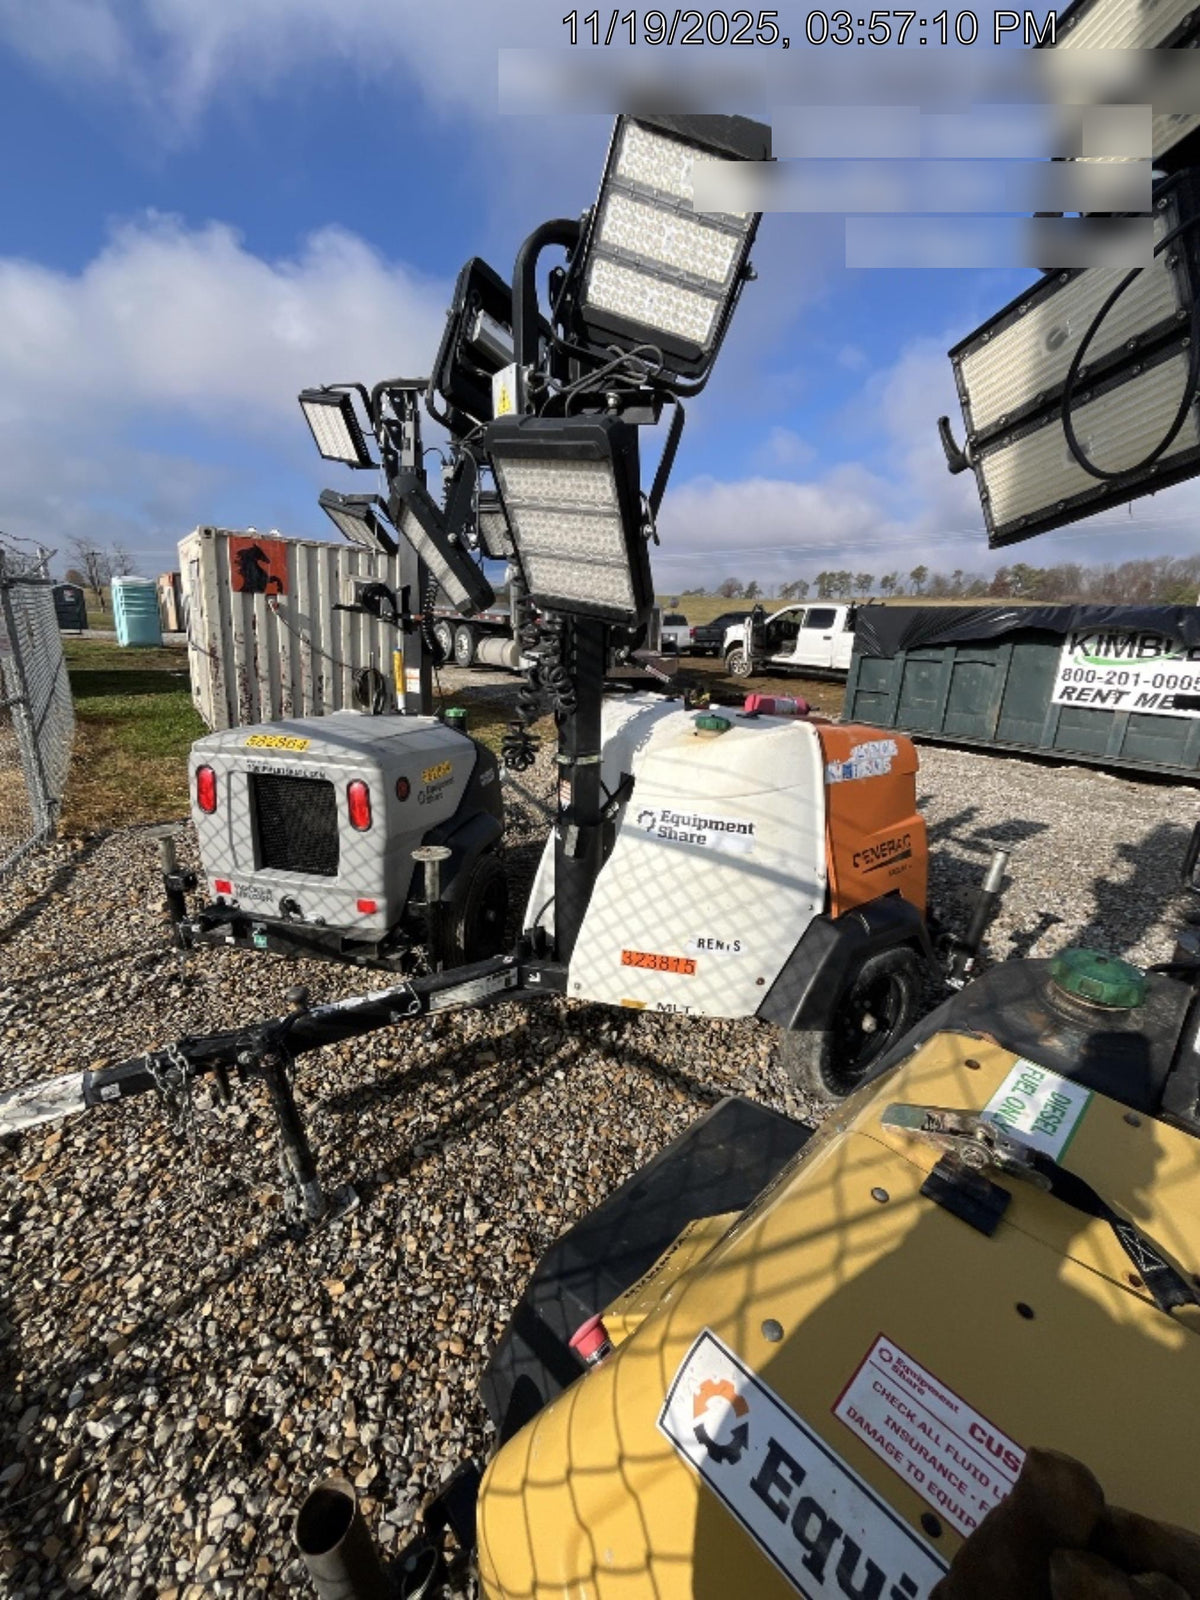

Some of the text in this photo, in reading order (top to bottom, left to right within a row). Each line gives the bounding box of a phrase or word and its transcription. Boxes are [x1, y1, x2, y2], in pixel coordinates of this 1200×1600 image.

[1059, 686, 1131, 705] RENT
[657, 826, 706, 845] Share
[659, 810, 755, 835] Equipment
[622, 950, 695, 975] 323815
[990, 1066, 1046, 1134] FUEL ONLY
[1030, 1091, 1072, 1137] DIESEL
[891, 1364, 925, 1396] Share
[896, 1357, 960, 1414] Equipment
[846, 1406, 904, 1462] DAMAGE
[906, 1461, 925, 1483] TO
[872, 1380, 917, 1422] CHECK
[918, 1422, 943, 1447] ALL
[944, 1444, 990, 1487] FLUID
[884, 1415, 968, 1495] INSURANCE
